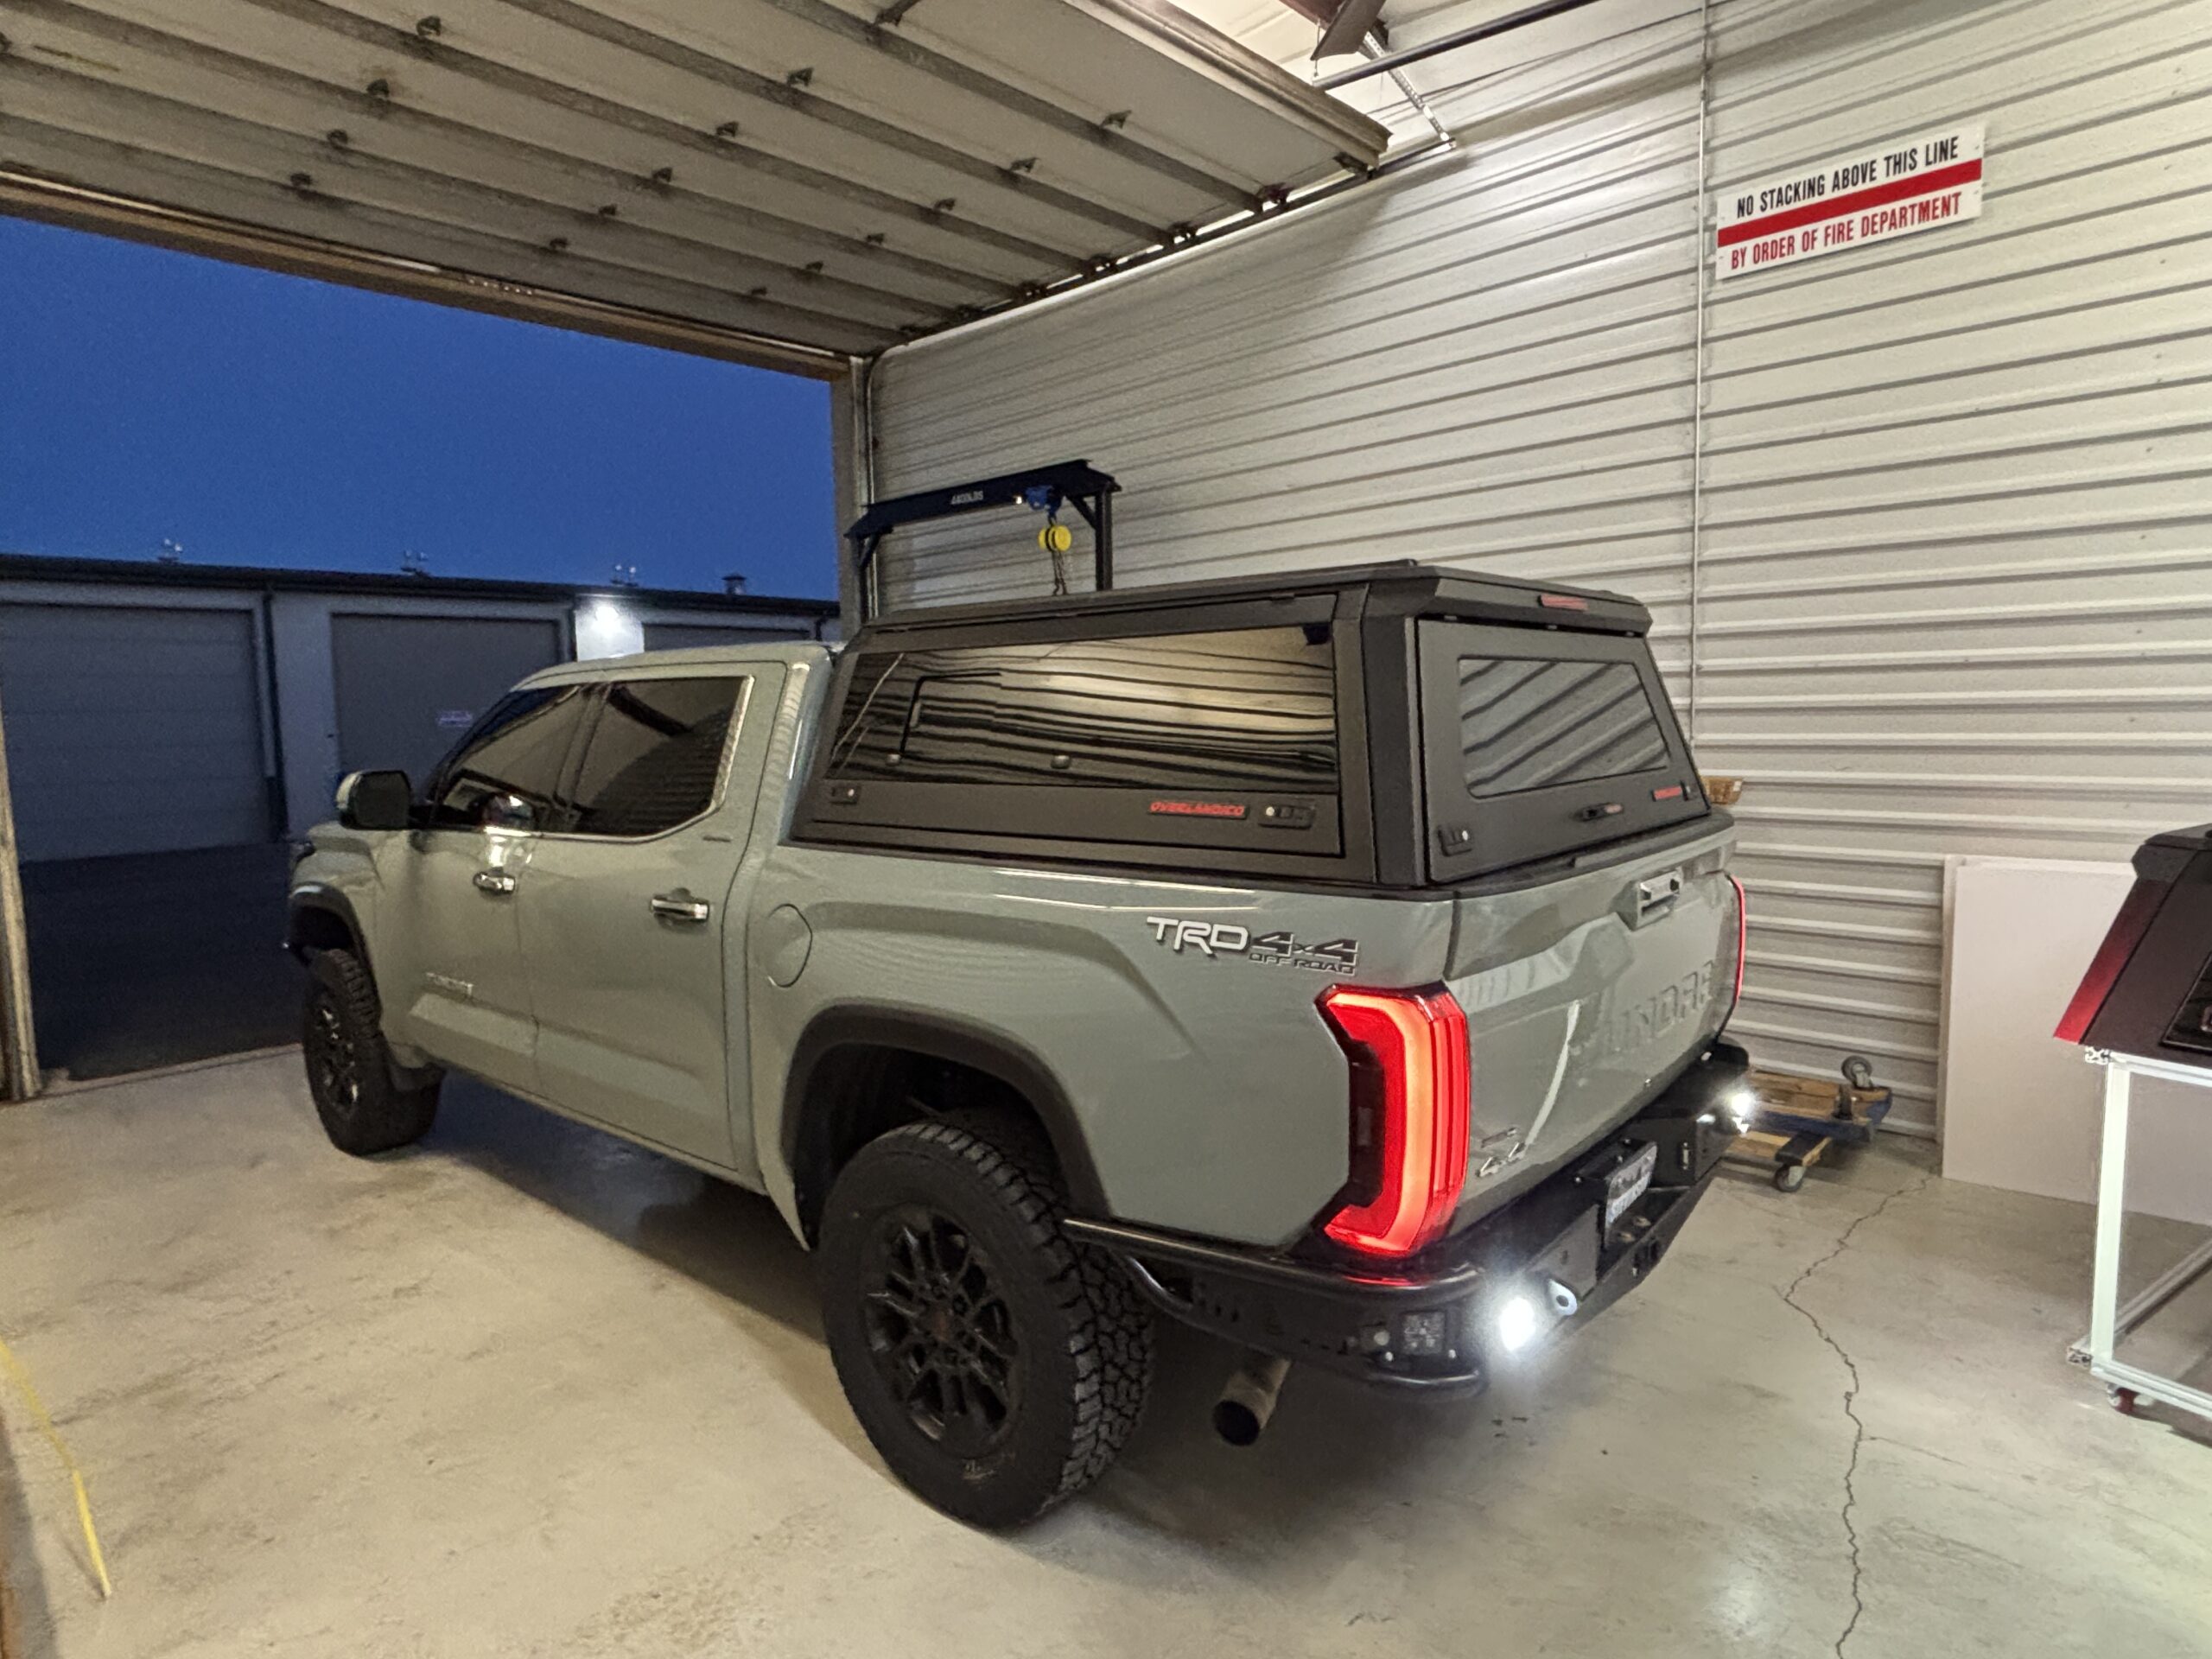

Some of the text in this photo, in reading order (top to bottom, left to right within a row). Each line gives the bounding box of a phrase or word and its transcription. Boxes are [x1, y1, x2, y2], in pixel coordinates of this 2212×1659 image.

[1737, 135, 1959, 218] NO STACKING ABOVE THIS LINE
[1731, 192, 1962, 270] BY ORDER OF FIRE DEPARTMENT
[1147, 916, 1359, 966] TRD 4x4
[1249, 953, 1356, 976] OFF ROAD
